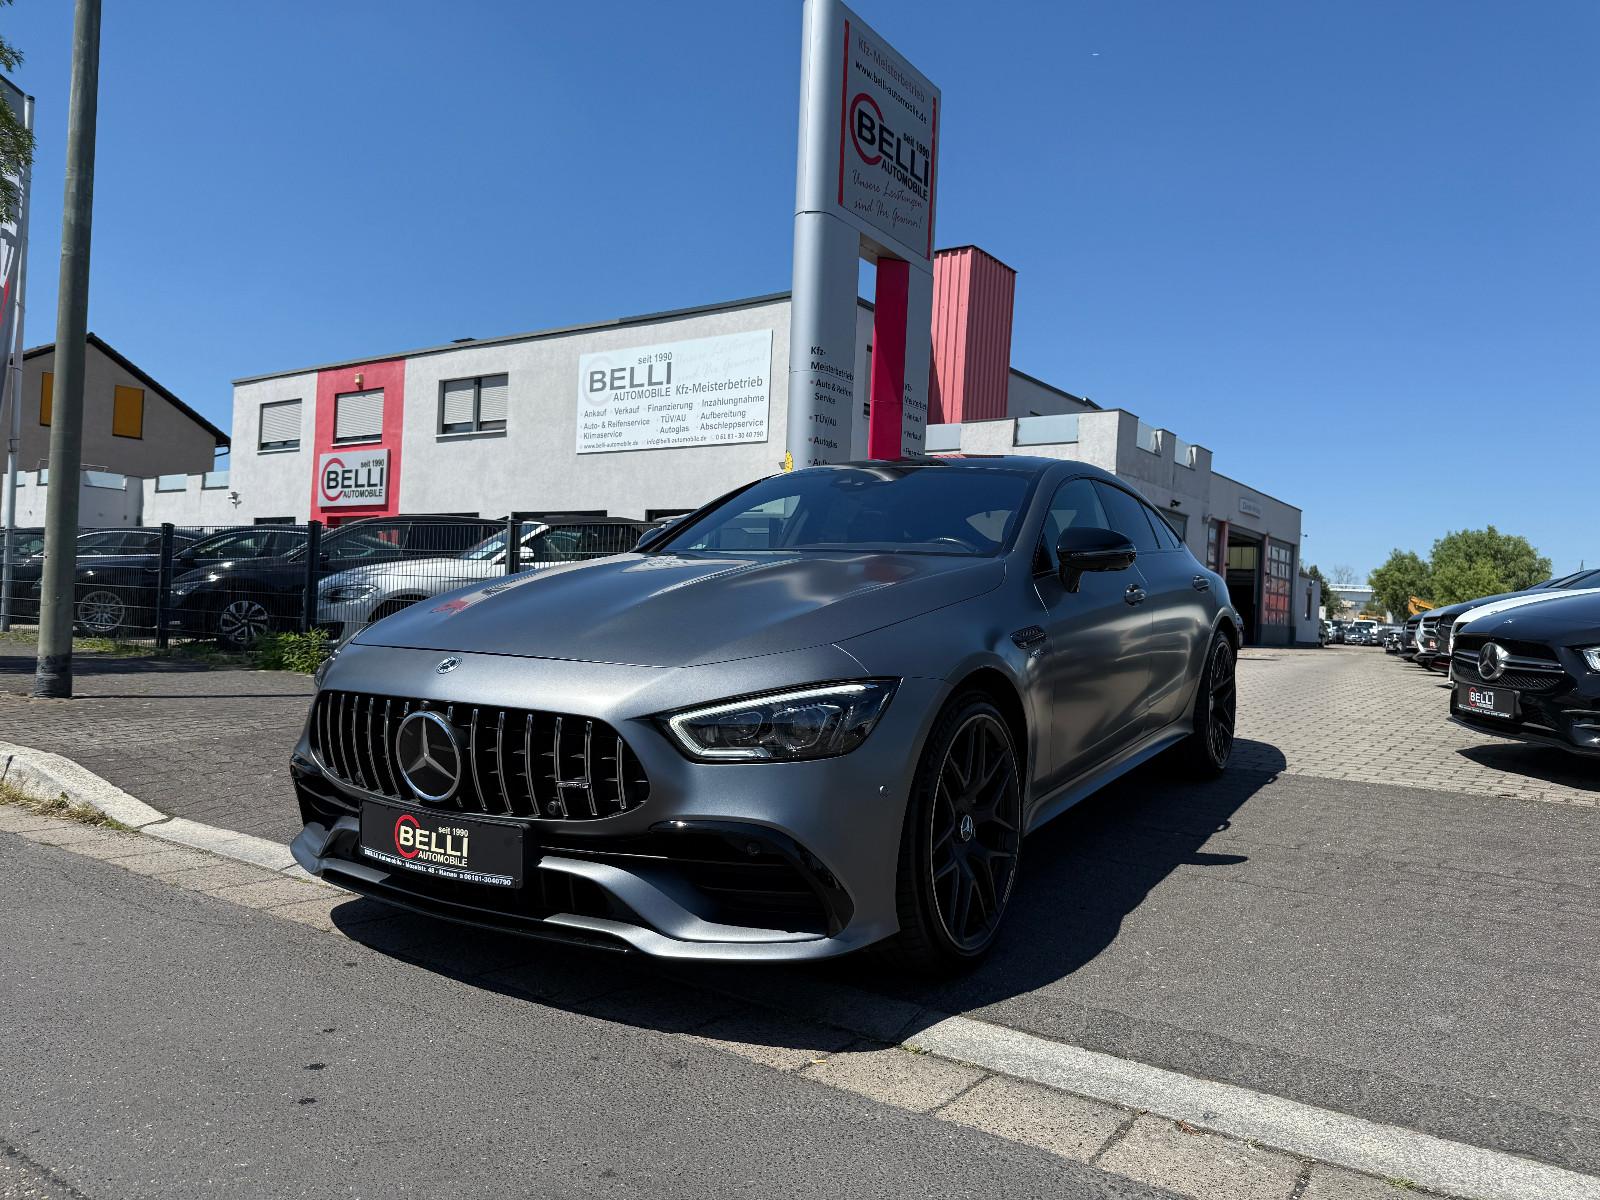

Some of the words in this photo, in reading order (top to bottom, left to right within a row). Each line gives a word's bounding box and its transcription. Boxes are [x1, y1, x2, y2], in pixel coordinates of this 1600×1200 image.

[858, 37, 924, 103] Kfz-Meisterbetrieb
[857, 108, 930, 188] BELLI
[903, 132, 914, 147] seit
[916, 140, 930, 159] 1990
[881, 161, 928, 201] AUTOMOBILE
[854, 198, 874, 212] sind
[638, 354, 652, 365] seit
[654, 351, 673, 363] 1990
[589, 361, 672, 393] BELLI
[675, 375, 763, 395] Kfz-Meisterbetrieb
[613, 386, 671, 402] AUTOMOBILE
[814, 392, 836, 405] Service
[584, 408, 607, 418] Ankauf
[614, 405, 640, 416] Verkauf
[647, 401, 694, 415] Finanzierung
[702, 394, 765, 410] Inzahlungnahme
[660, 414, 687, 424] TÜV/AU
[700, 409, 746, 422] Aufbereitung
[584, 420, 601, 430] Auto-
[601, 420, 606, 428] &
[608, 418, 650, 428] Reifenservice
[660, 426, 690, 436] Autoglas
[700, 418, 764, 432] Abschleppservice
[584, 430, 623, 440] Klimaservice
[360, 460, 371, 468] seit
[372, 458, 385, 467] 1990
[326, 467, 384, 490] BELLI
[343, 488, 383, 498] AUTOMOBILE
[1470, 691, 1494, 705] BELLI
[438, 826, 451, 835] seit
[452, 827, 469, 837] 1990
[399, 825, 469, 857] BELLI
[418, 850, 468, 867] AUTOMOBILE
